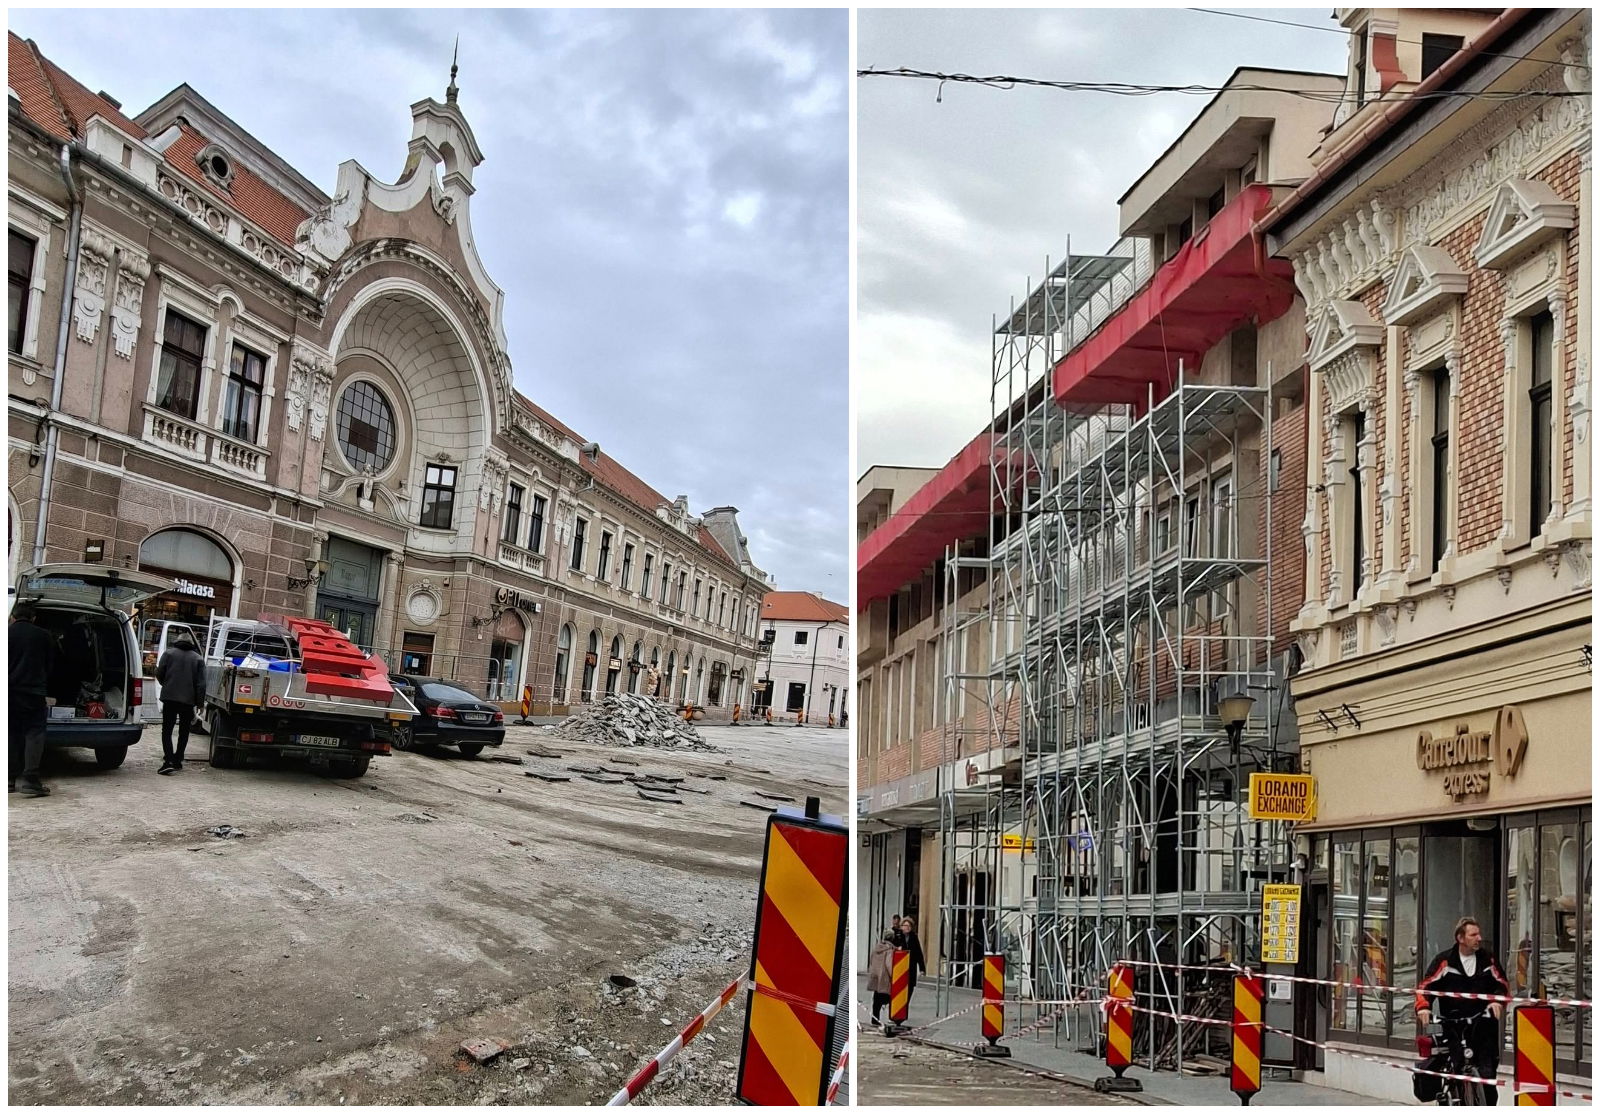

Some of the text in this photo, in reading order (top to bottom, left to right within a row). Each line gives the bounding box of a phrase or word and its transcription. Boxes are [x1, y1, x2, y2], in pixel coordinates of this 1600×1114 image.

[1416, 723, 1491, 770] Carrefour
[1258, 780, 1307, 798] LORAND
[1443, 770, 1490, 803] express
[1257, 796, 1307, 814] EXCHANGE
